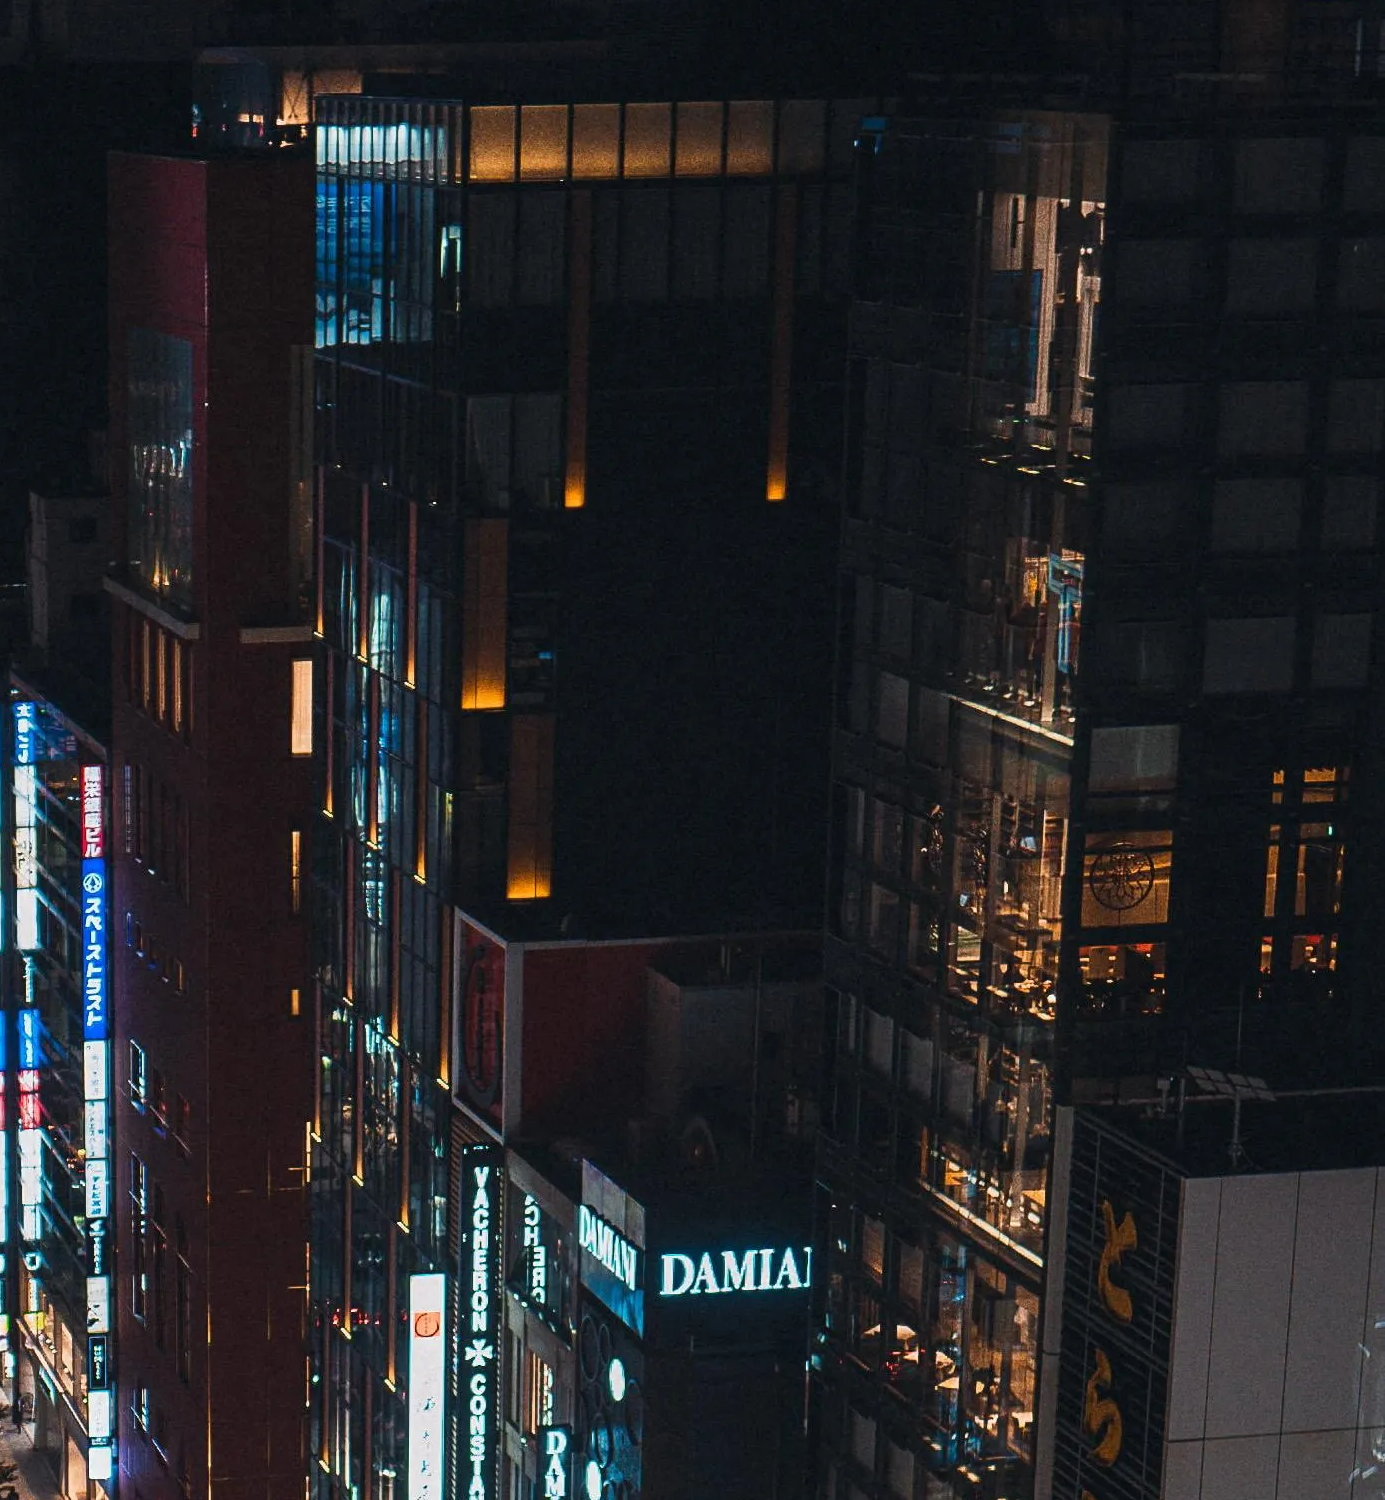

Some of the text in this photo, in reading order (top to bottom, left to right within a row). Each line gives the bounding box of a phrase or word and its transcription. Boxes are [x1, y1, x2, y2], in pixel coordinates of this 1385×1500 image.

[85, 896, 102, 1027] スペーストラスト
[471, 1165, 490, 1333] VACHERON
[578, 1204, 637, 1291] DAMIANI
